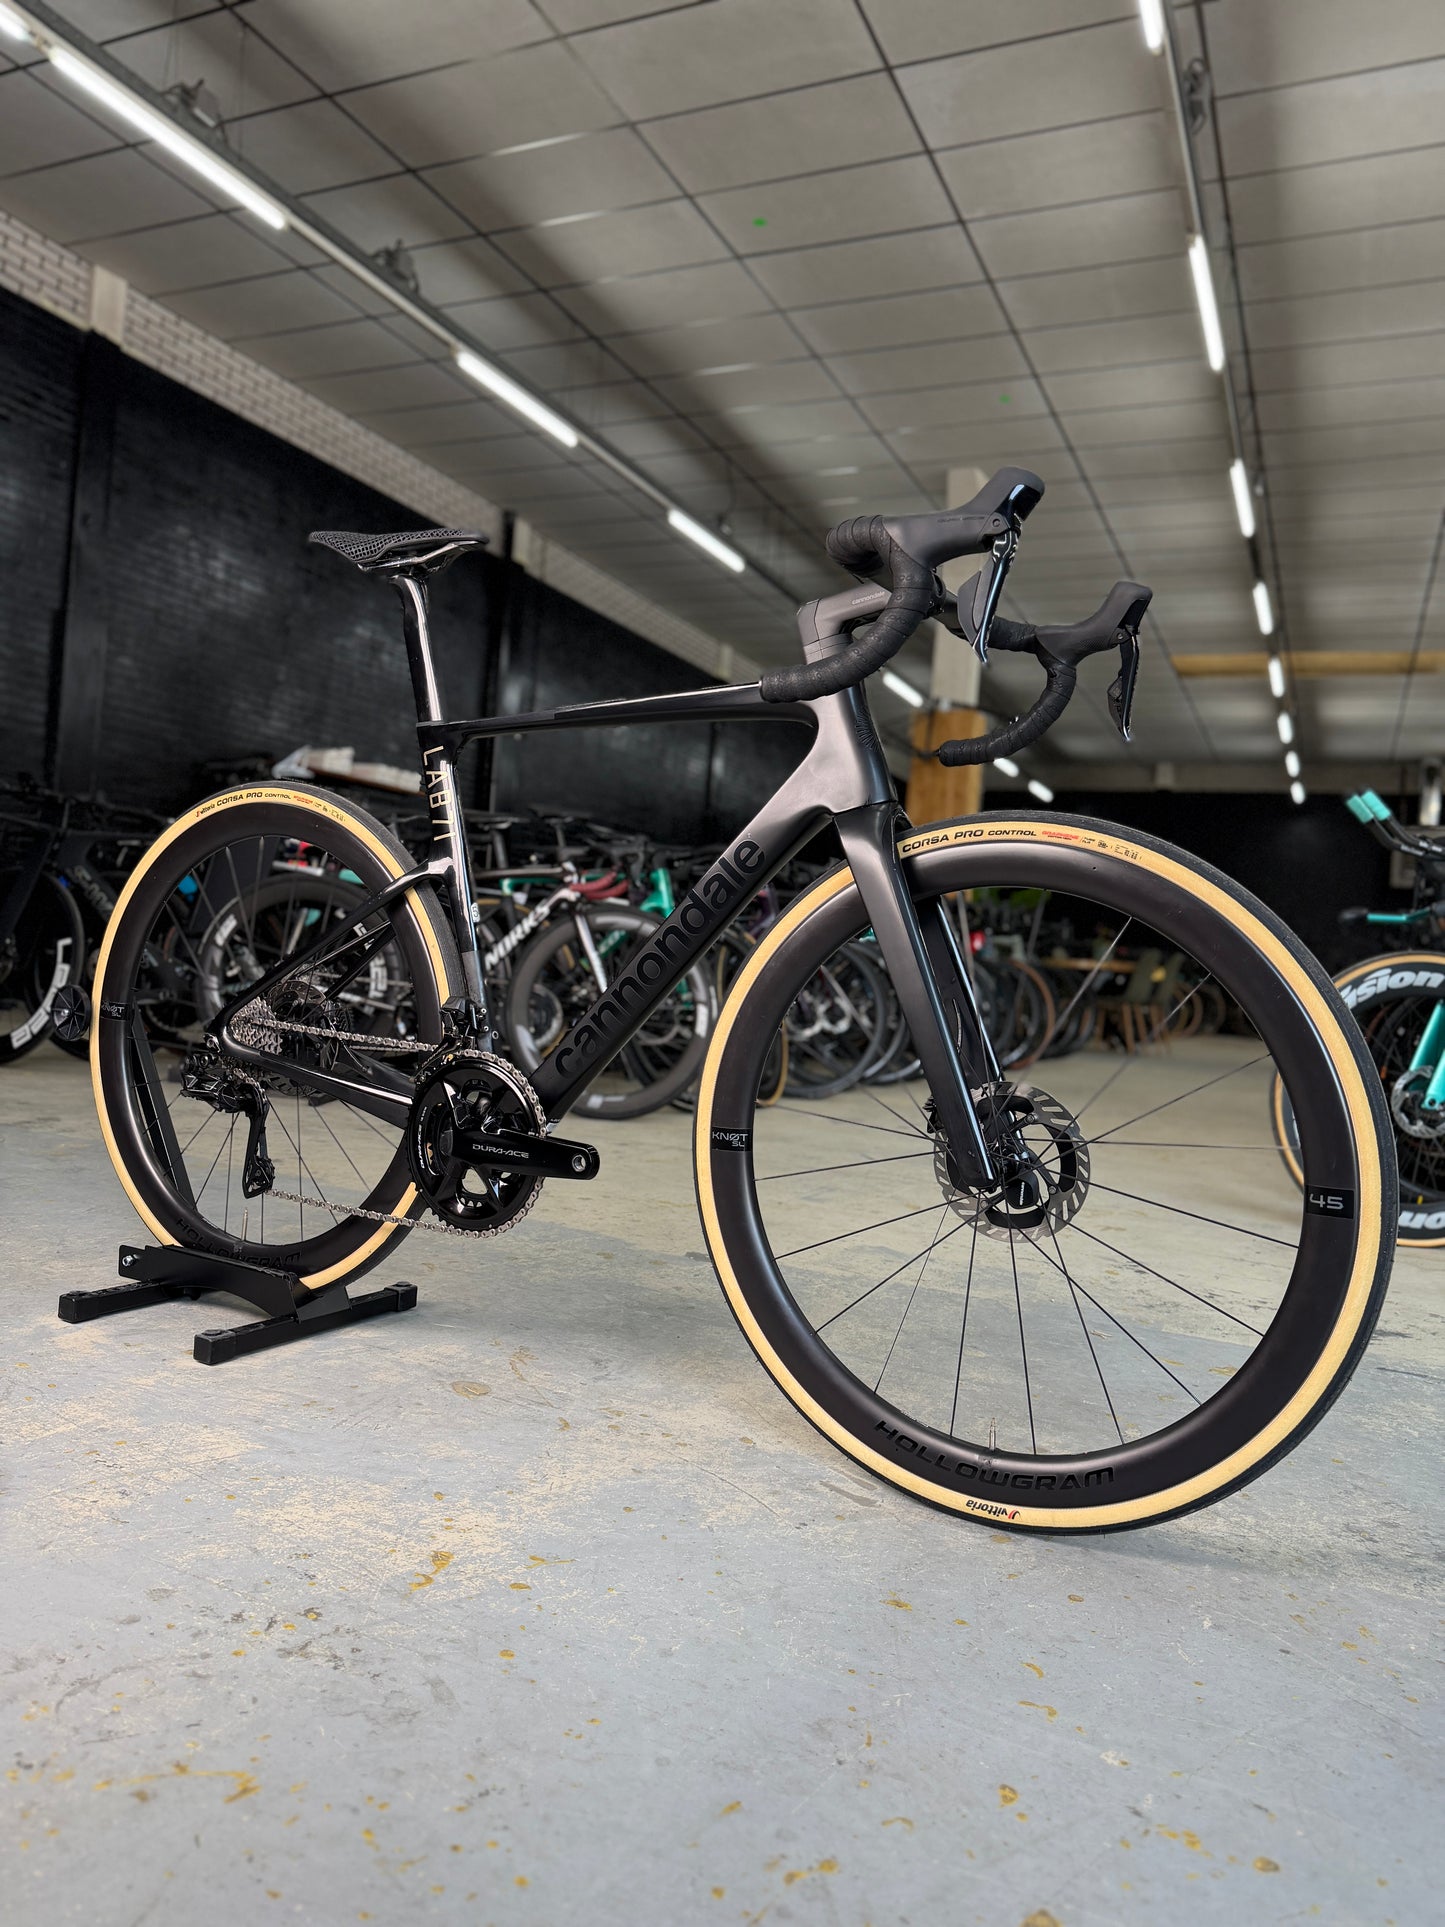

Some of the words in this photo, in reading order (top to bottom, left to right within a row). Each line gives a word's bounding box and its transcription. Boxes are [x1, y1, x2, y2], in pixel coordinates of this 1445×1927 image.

[216, 794, 244, 807] CORSA
[246, 791, 263, 799] PRO
[423, 745, 456, 842] LAB71
[902, 834, 949, 853] CORSA
[954, 829, 984, 840] PRO
[988, 829, 1037, 837] CONTROL
[555, 840, 766, 1077] cannondale
[1340, 967, 1445, 1010] ision
[472, 1143, 529, 1159] DURA-ACE
[1309, 1193, 1344, 1210] 45
[873, 1420, 1115, 1491] HOLLOWGRAM
[965, 1499, 1010, 1519] vittoria
